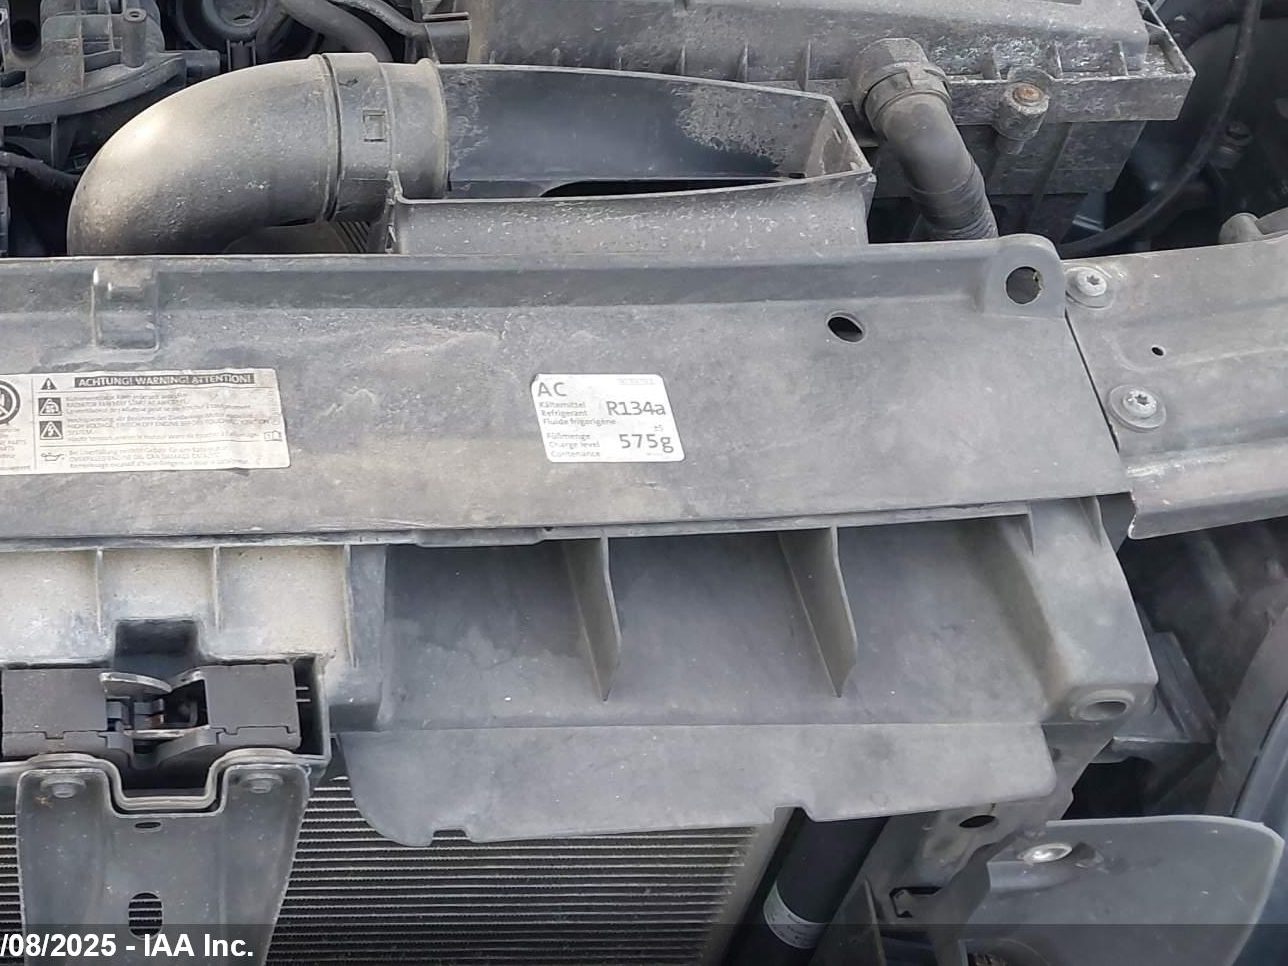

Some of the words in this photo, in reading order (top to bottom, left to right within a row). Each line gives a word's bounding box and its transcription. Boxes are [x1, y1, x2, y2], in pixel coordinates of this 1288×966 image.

[78, 377, 133, 387] ACHTUNG!
[135, 376, 189, 386] WARNING!
[191, 374, 252, 385] ATTENTION!
[605, 400, 667, 416] R134a
[618, 433, 675, 453] 575g
